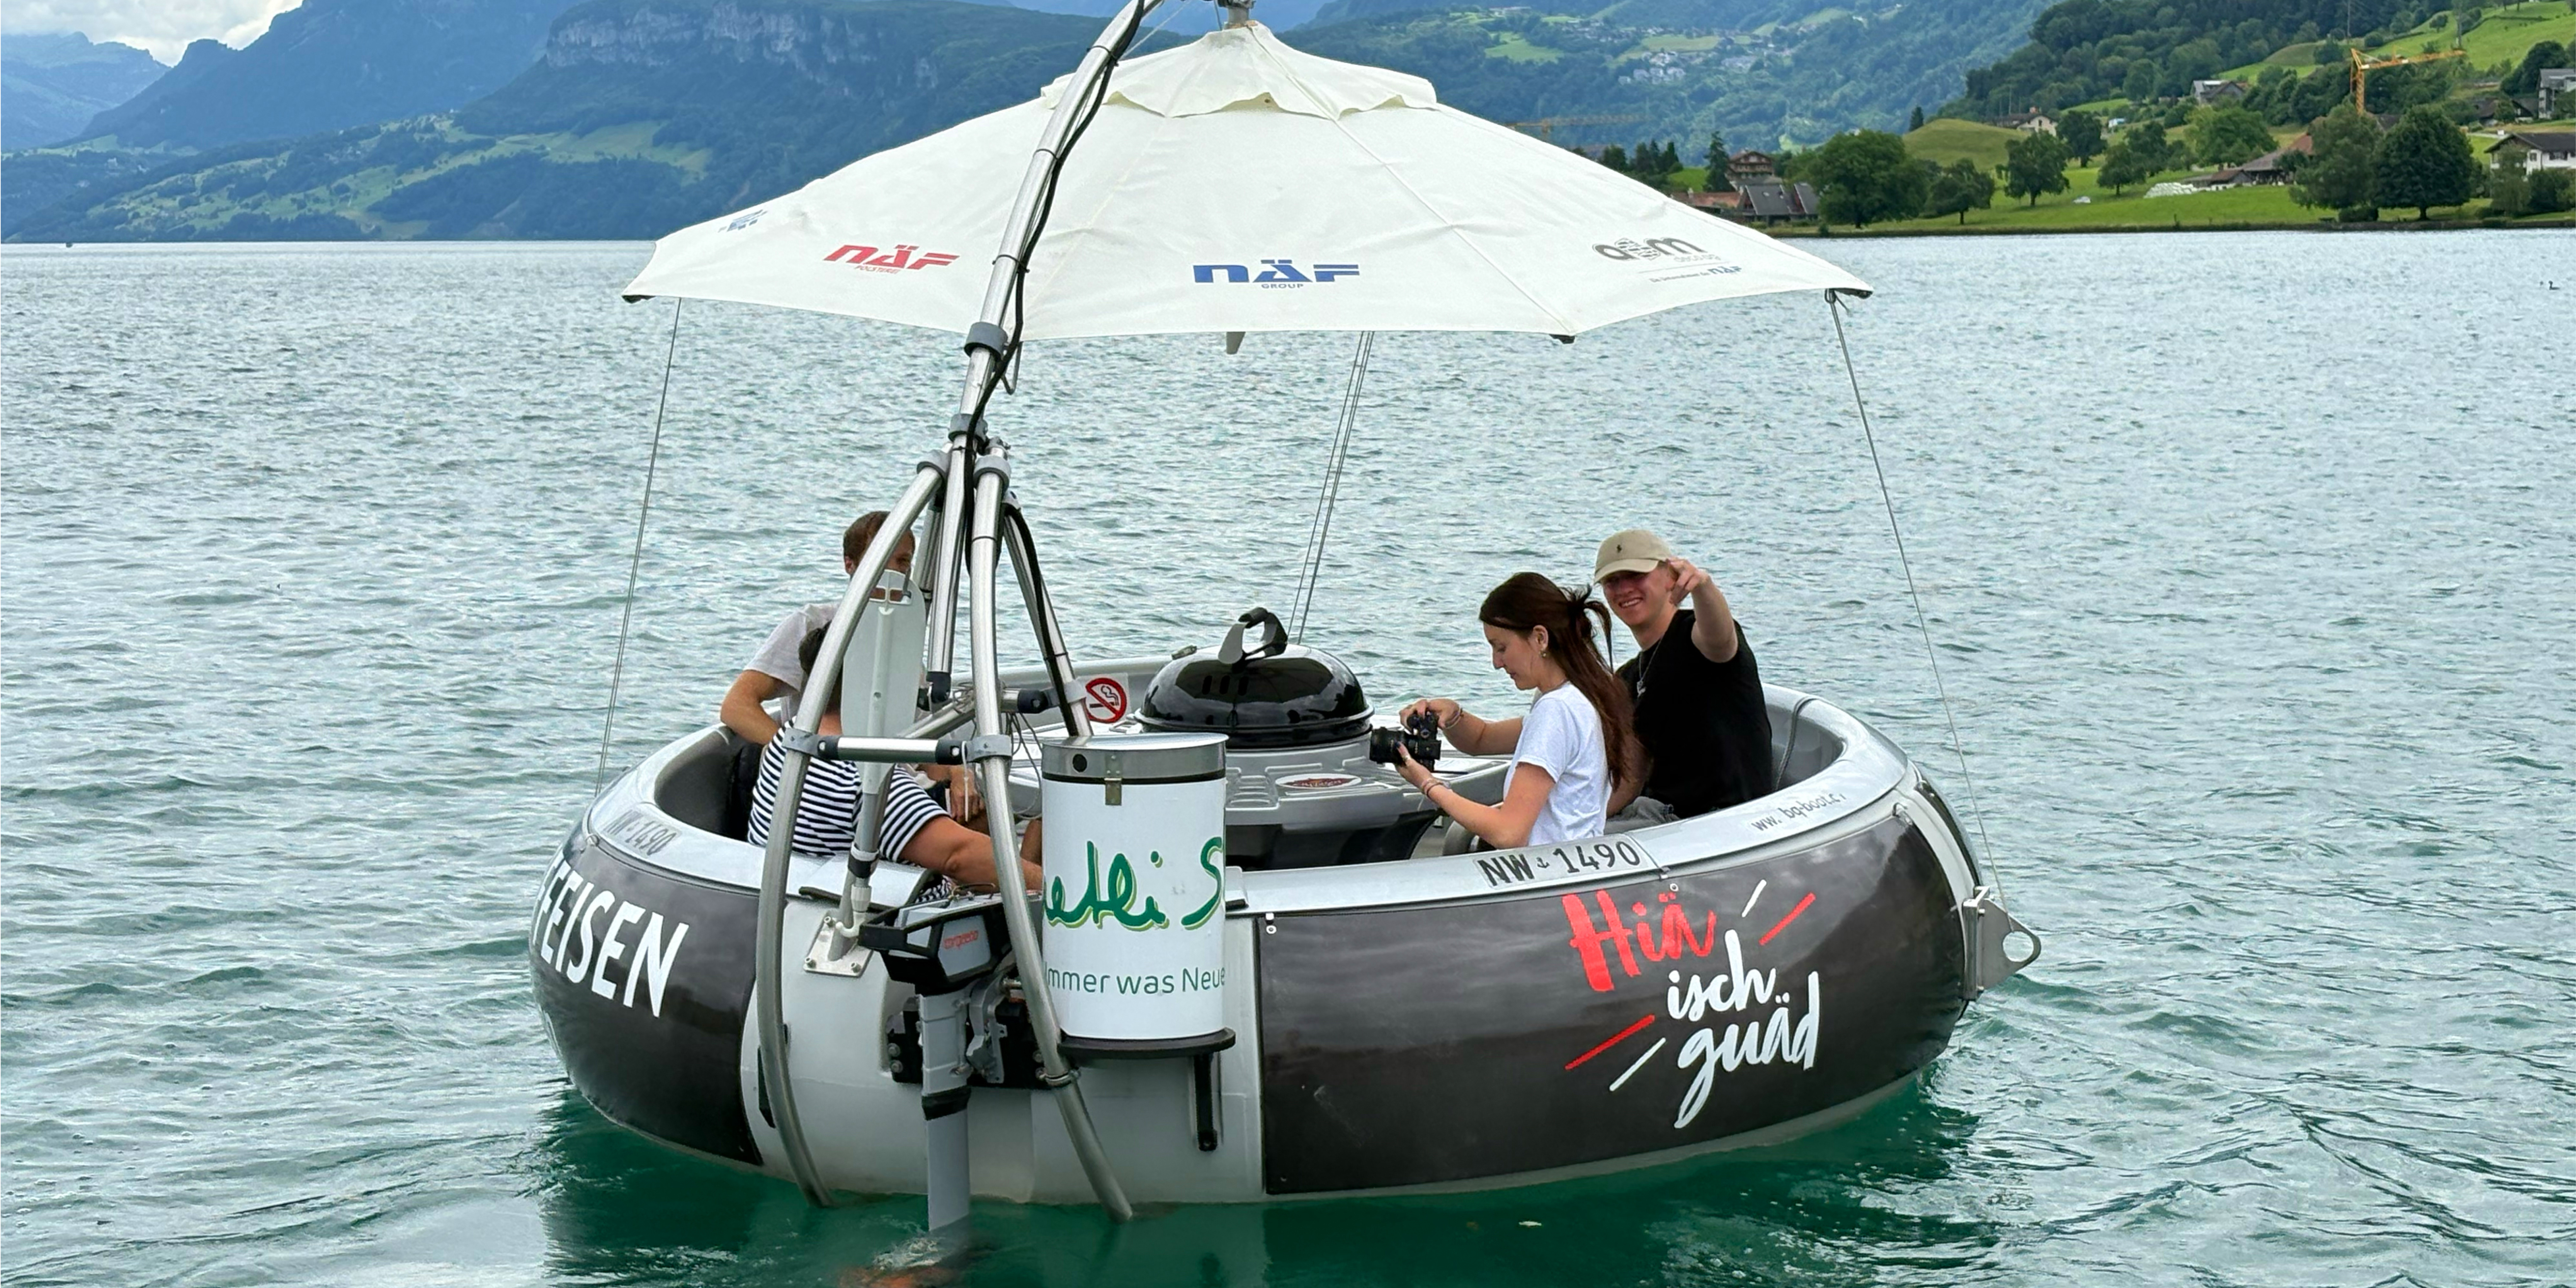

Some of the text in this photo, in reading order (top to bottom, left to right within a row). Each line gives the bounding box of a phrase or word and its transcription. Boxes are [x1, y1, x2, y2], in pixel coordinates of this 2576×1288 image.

[1477, 841, 1641, 886] NW 1490
[1116, 975, 1174, 995] was
[1666, 929, 1776, 1021] isch
[1674, 971, 1820, 1128] guäd
